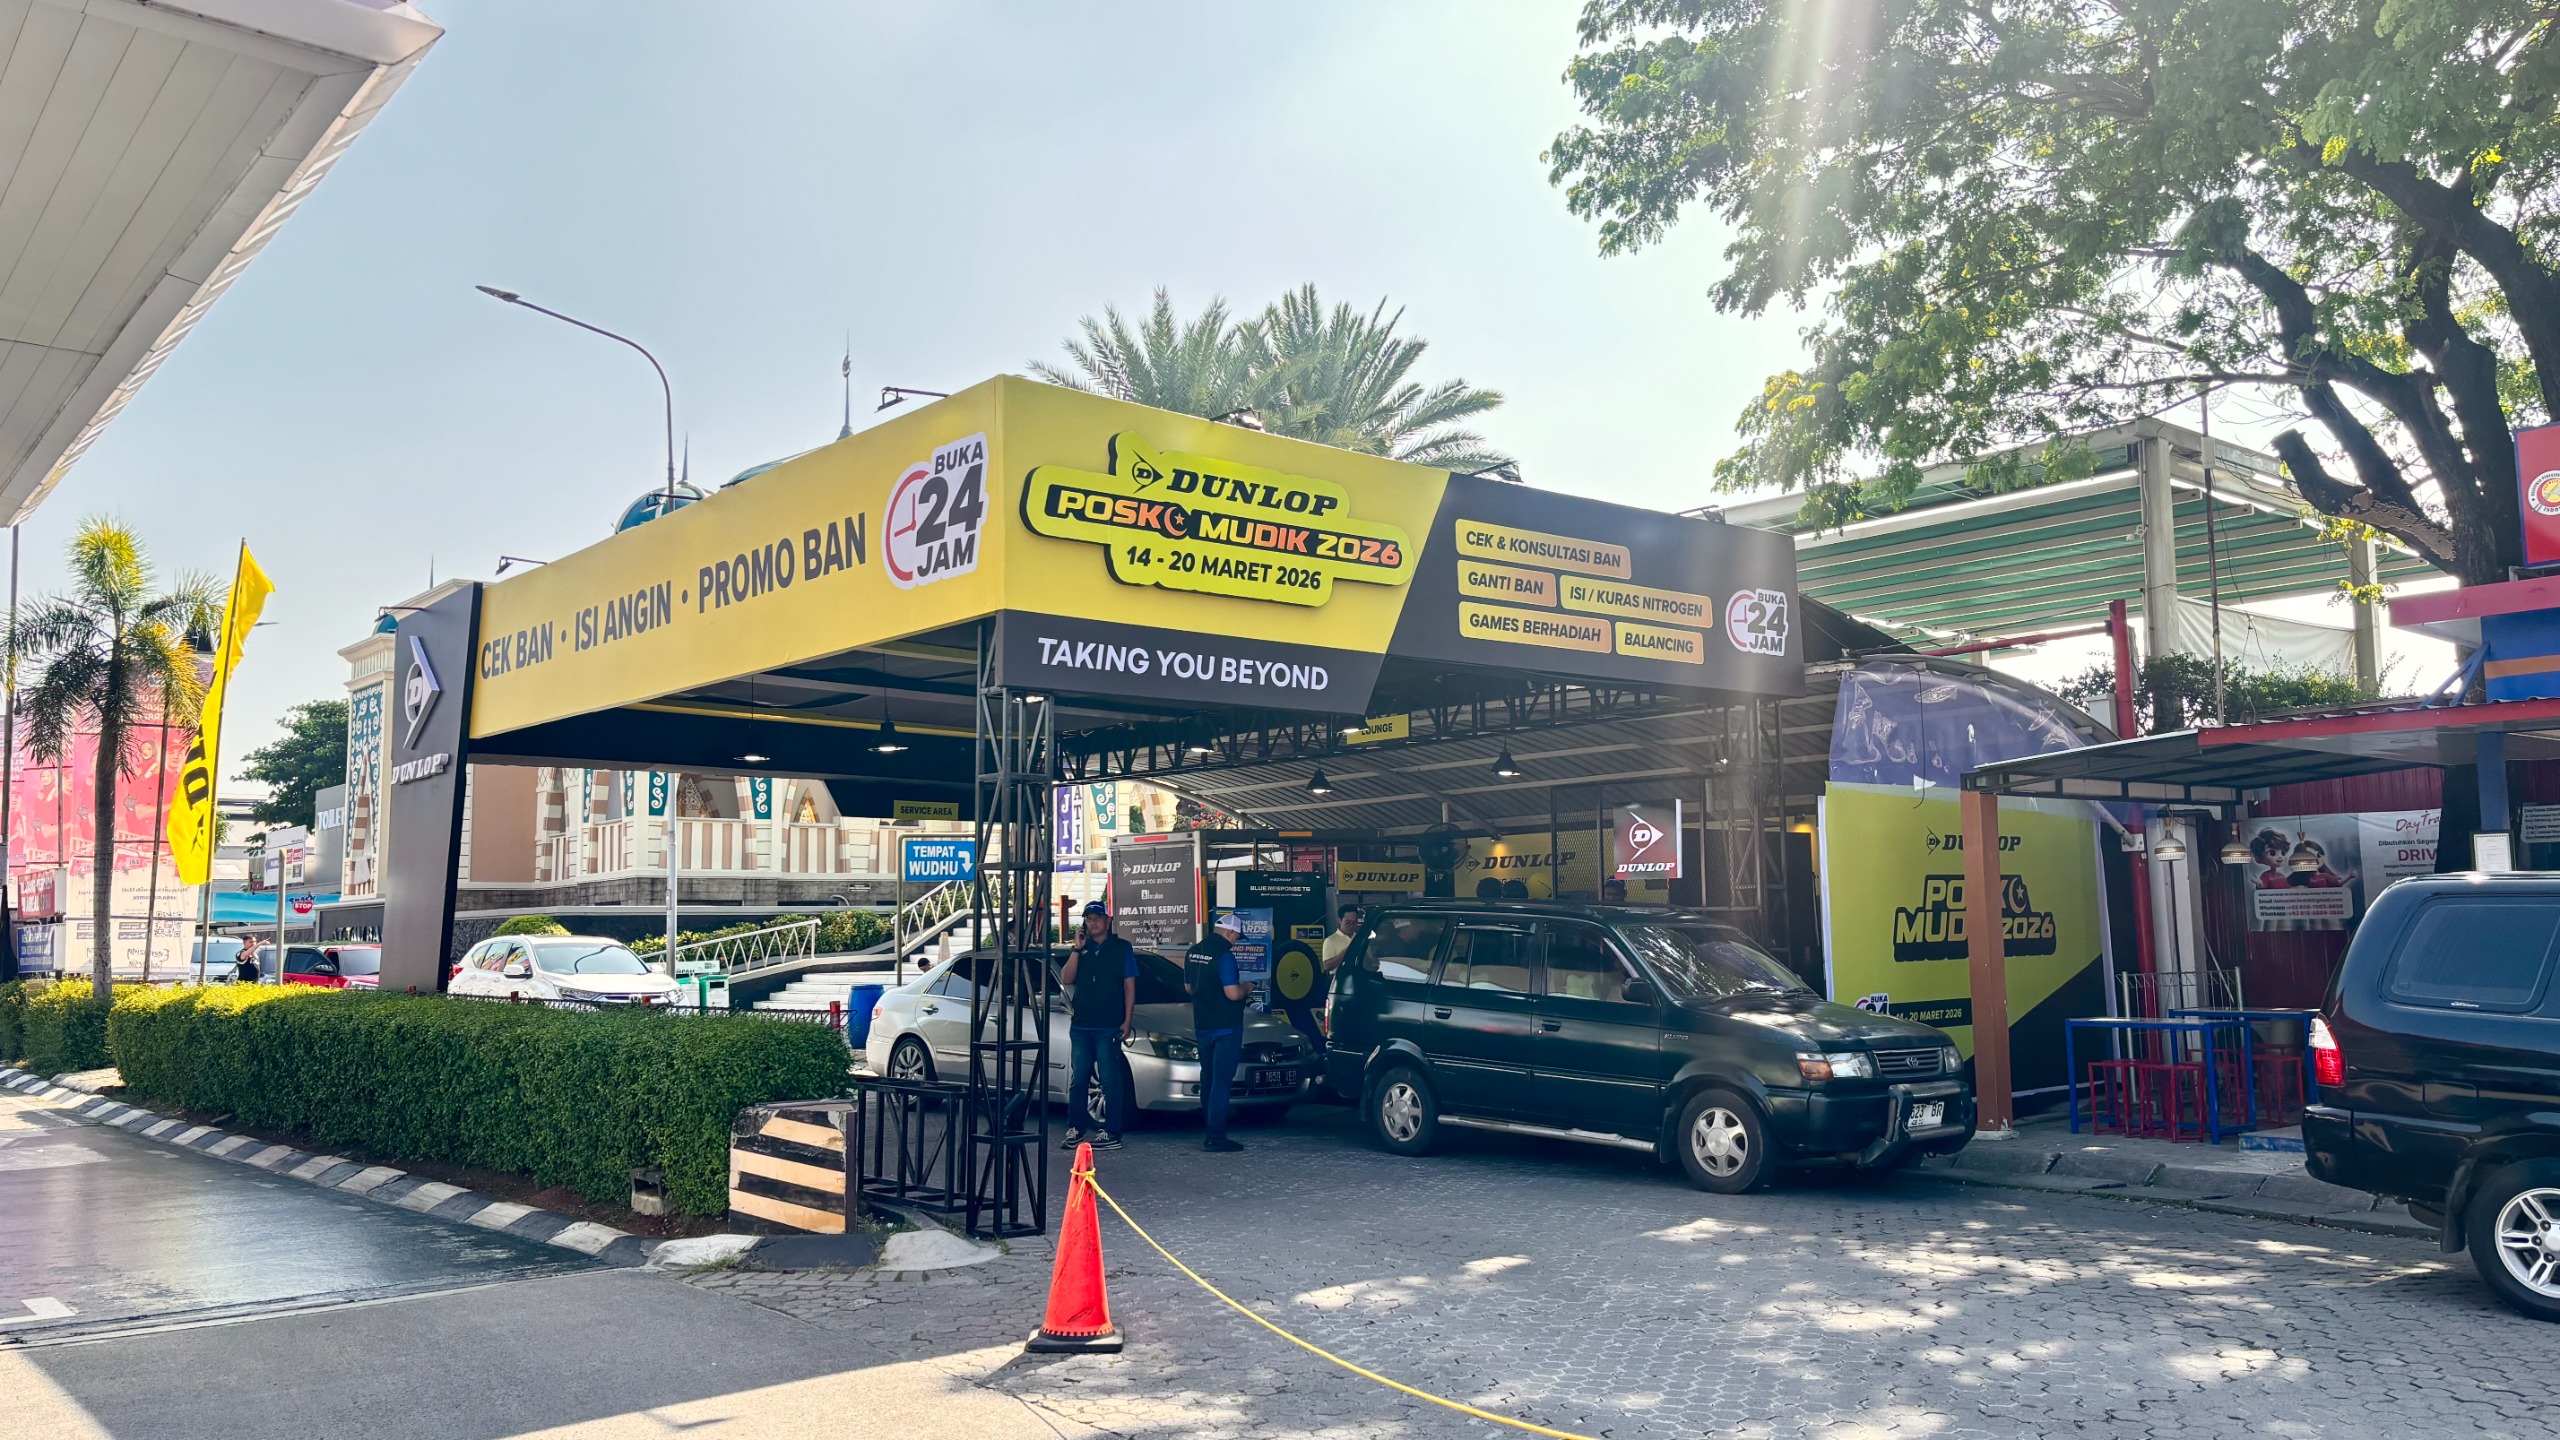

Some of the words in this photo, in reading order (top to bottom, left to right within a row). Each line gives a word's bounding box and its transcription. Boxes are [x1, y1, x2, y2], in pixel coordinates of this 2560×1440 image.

[934, 439, 984, 475] BUKA
[915, 463, 985, 547] 24
[1166, 468, 1338, 517] DUNLOP
[1200, 511, 1308, 553] MUDIK
[1316, 532, 1401, 567] 2026
[1466, 531, 1494, 549] CEK
[1497, 536, 1506, 550] &
[1509, 537, 1591, 564] KONSULTASI
[1593, 551, 1622, 568] BAN
[699, 537, 795, 614] PROMO
[803, 511, 867, 582] BAN
[916, 533, 975, 578] JAM
[1126, 546, 1152, 567] 14
[1169, 552, 1196, 574] 20
[1200, 556, 1273, 583] MARET
[1275, 565, 1322, 591] 2026
[1467, 571, 1511, 591] GANTI
[1514, 577, 1544, 596] BAN
[1569, 586, 1586, 602] ISI
[1597, 588, 1639, 610] KURAS
[1643, 593, 1703, 618] NITROGEN
[1757, 593, 1785, 606] BUKA
[574, 606, 598, 653] ISI
[603, 580, 673, 646] ANGIN
[1469, 613, 1519, 634] GAMES
[1523, 619, 1602, 643] BERHADIAH
[1746, 601, 1786, 638] 24
[481, 635, 512, 680] CEK
[516, 620, 554, 670] BAN
[1624, 632, 1694, 654] BALANCING
[1749, 635, 1783, 653] JAM
[1037, 637, 1149, 674] TAKING
[1156, 651, 1215, 681] YOU
[1220, 656, 1329, 691] BEYOND
[391, 753, 447, 785] DUNLOP
[900, 805, 932, 815] SERVICE
[933, 807, 953, 816] AREA
[913, 846, 955, 858] TEMPAT
[1942, 834, 2021, 851] DOP
[909, 860, 959, 876] WUDHU
[1131, 862, 1181, 875] DUNLOP
[1482, 852, 1576, 870] DUNLOP
[1616, 861, 1676, 874] DUNLOP
[1354, 871, 1420, 883] DUNLOP
[294, 902, 312, 910] STOP
[1119, 907, 1138, 916] HRA
[1139, 906, 1156, 915] TYRE
[1158, 905, 1188, 914] SERVICE
[1896, 912, 1969, 944] MUD
[2002, 915, 2054, 940] 2026
[1871, 995, 1888, 1003] BUKA
[1909, 1012, 1918, 1021] 20
[1920, 1010, 1944, 1020] MARET
[1945, 1008, 1962, 1019] 2026
